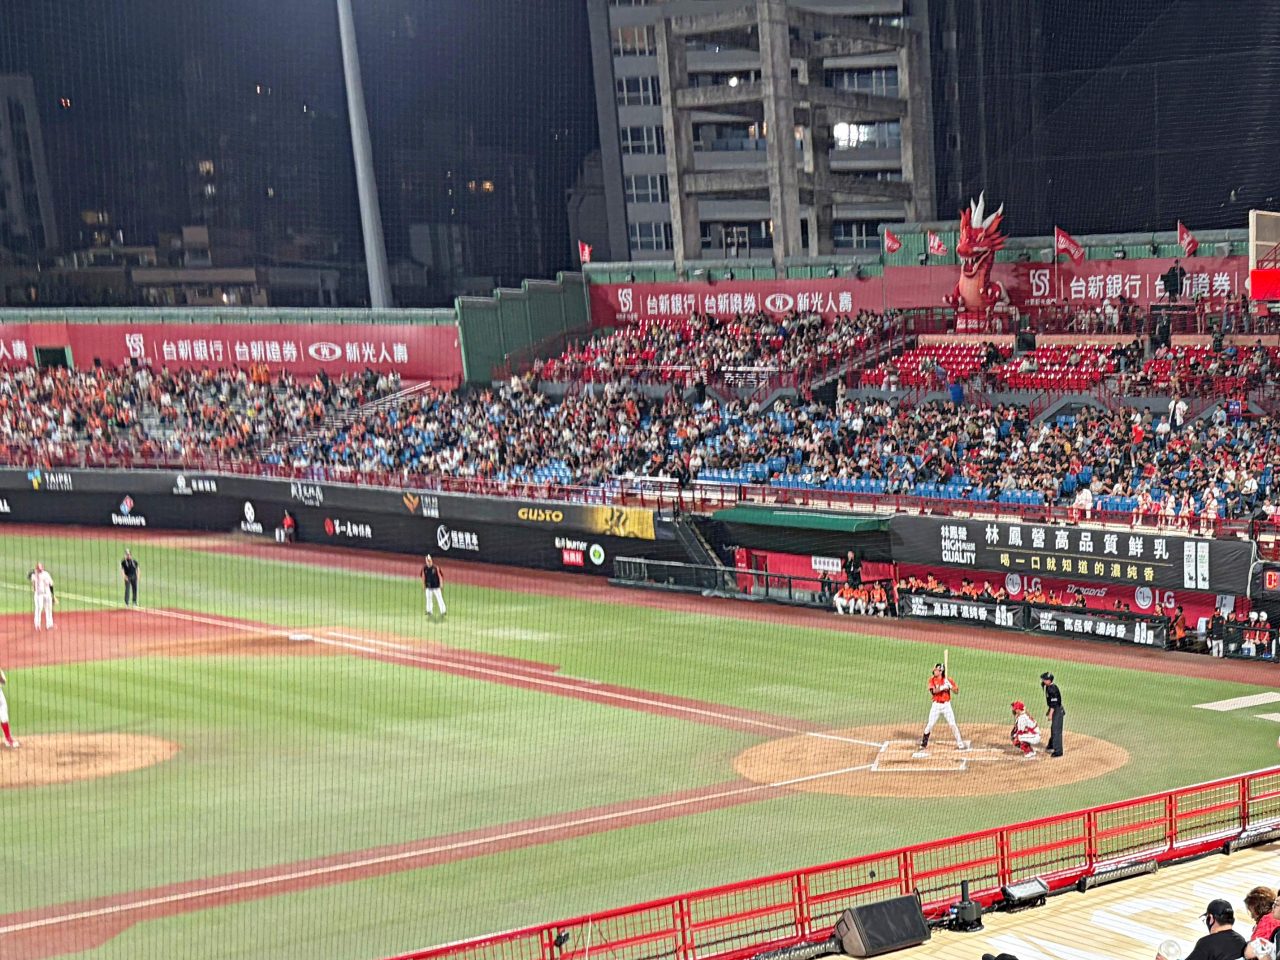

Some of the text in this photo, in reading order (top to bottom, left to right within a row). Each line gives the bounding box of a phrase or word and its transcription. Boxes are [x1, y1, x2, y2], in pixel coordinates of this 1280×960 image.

[1069, 272, 1142, 300] 台新銀行
[646, 293, 696, 316] 台新銀行
[796, 291, 853, 313] 新光人壽
[162, 338, 224, 362] 台新銀行
[345, 341, 409, 364] 新光人壽
[111, 512, 146, 527] Domino's
[517, 507, 564, 523] GUSTO
[941, 538, 963, 551] HIGH
[985, 523, 1170, 560] 林鳳營高品質鮮乳
[941, 550, 977, 565] QUALITY
[1000, 552, 1155, 582] 喝一口就知道的濃純香
[1155, 590, 1175, 608] LG
